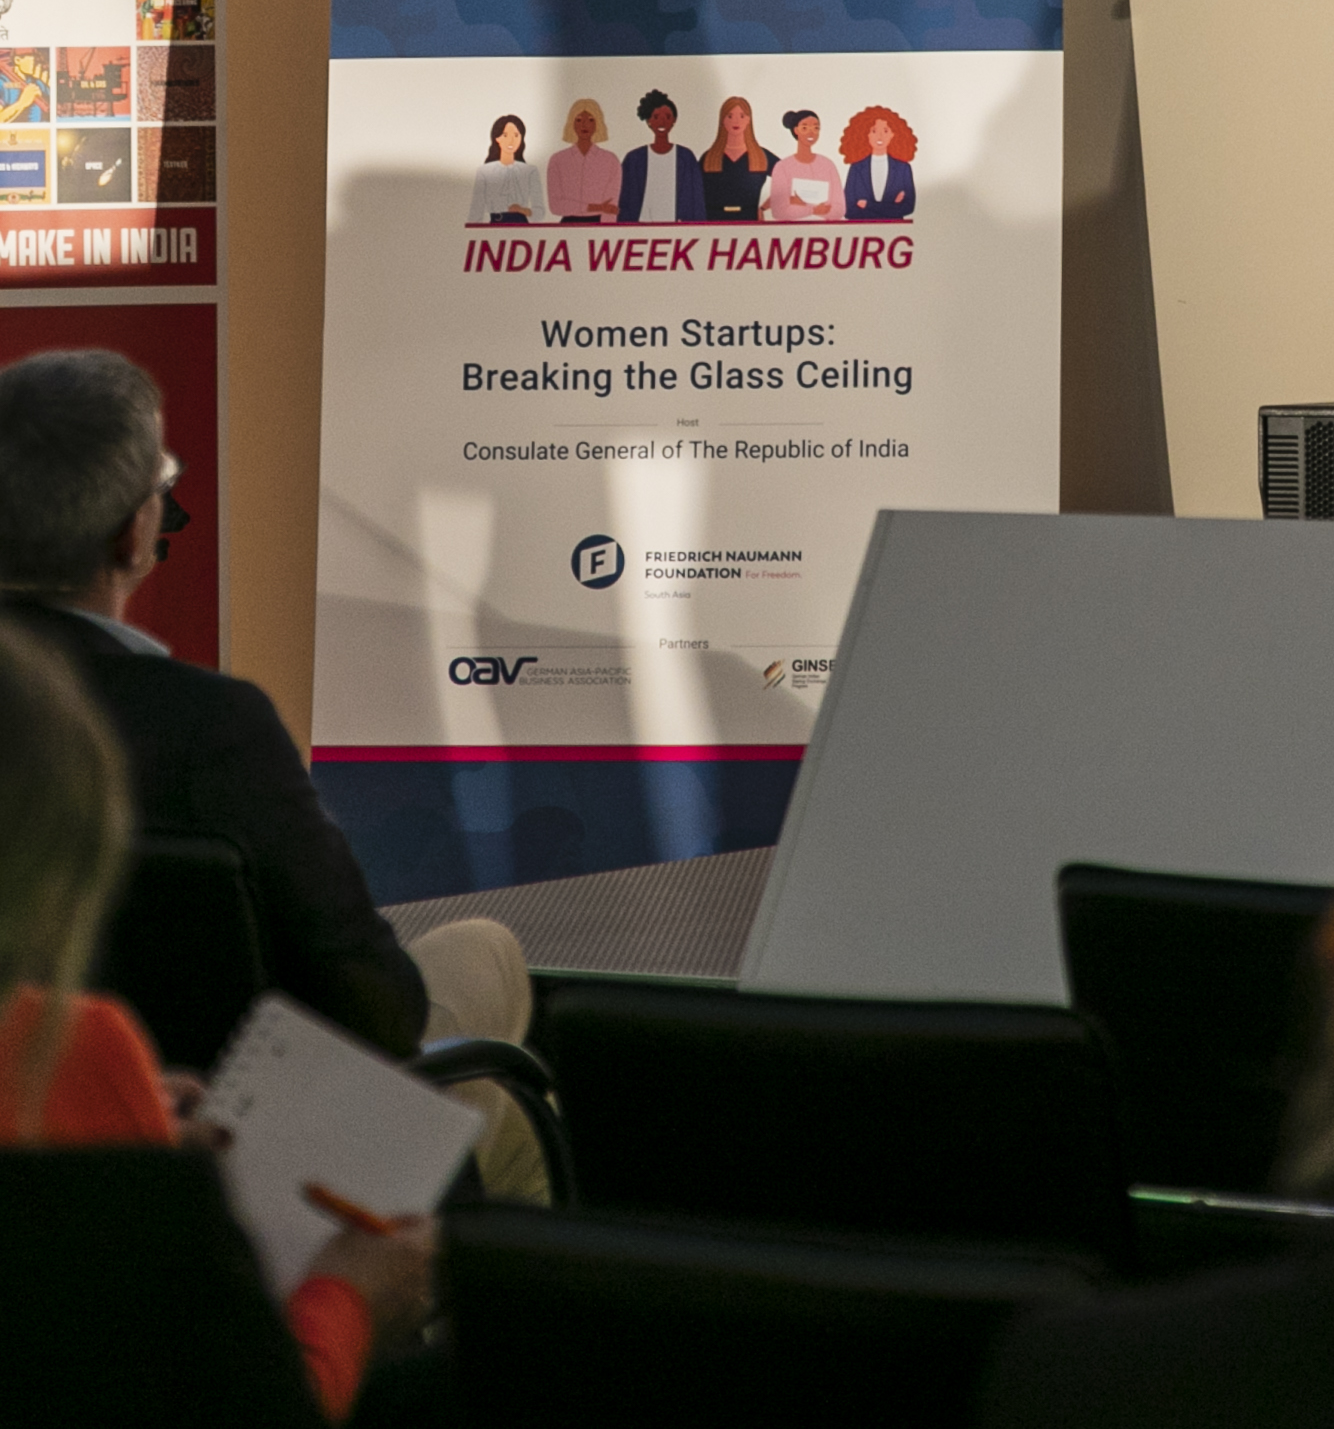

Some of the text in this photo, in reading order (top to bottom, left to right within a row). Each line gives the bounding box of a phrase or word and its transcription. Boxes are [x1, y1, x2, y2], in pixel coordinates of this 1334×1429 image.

[0, 227, 198, 266] MAKE IN INDIA
[464, 236, 914, 272] INDIA WEEK HAMBURG
[541, 319, 835, 353] Women Startups:
[463, 360, 913, 397] Breaking the Glass Ceiling
[677, 418, 699, 427] Host
[463, 438, 909, 462] Consulate General of The Republic of India
[645, 550, 802, 562] FRIEDRICH NAUMANN
[645, 568, 741, 579] FOUNDATION
[746, 571, 759, 579] For
[644, 590, 691, 599] South Asia
[659, 638, 709, 649] Partners
[792, 659, 836, 672] GINSE
[519, 677, 632, 685] BUSINESS ASSOCIATION
